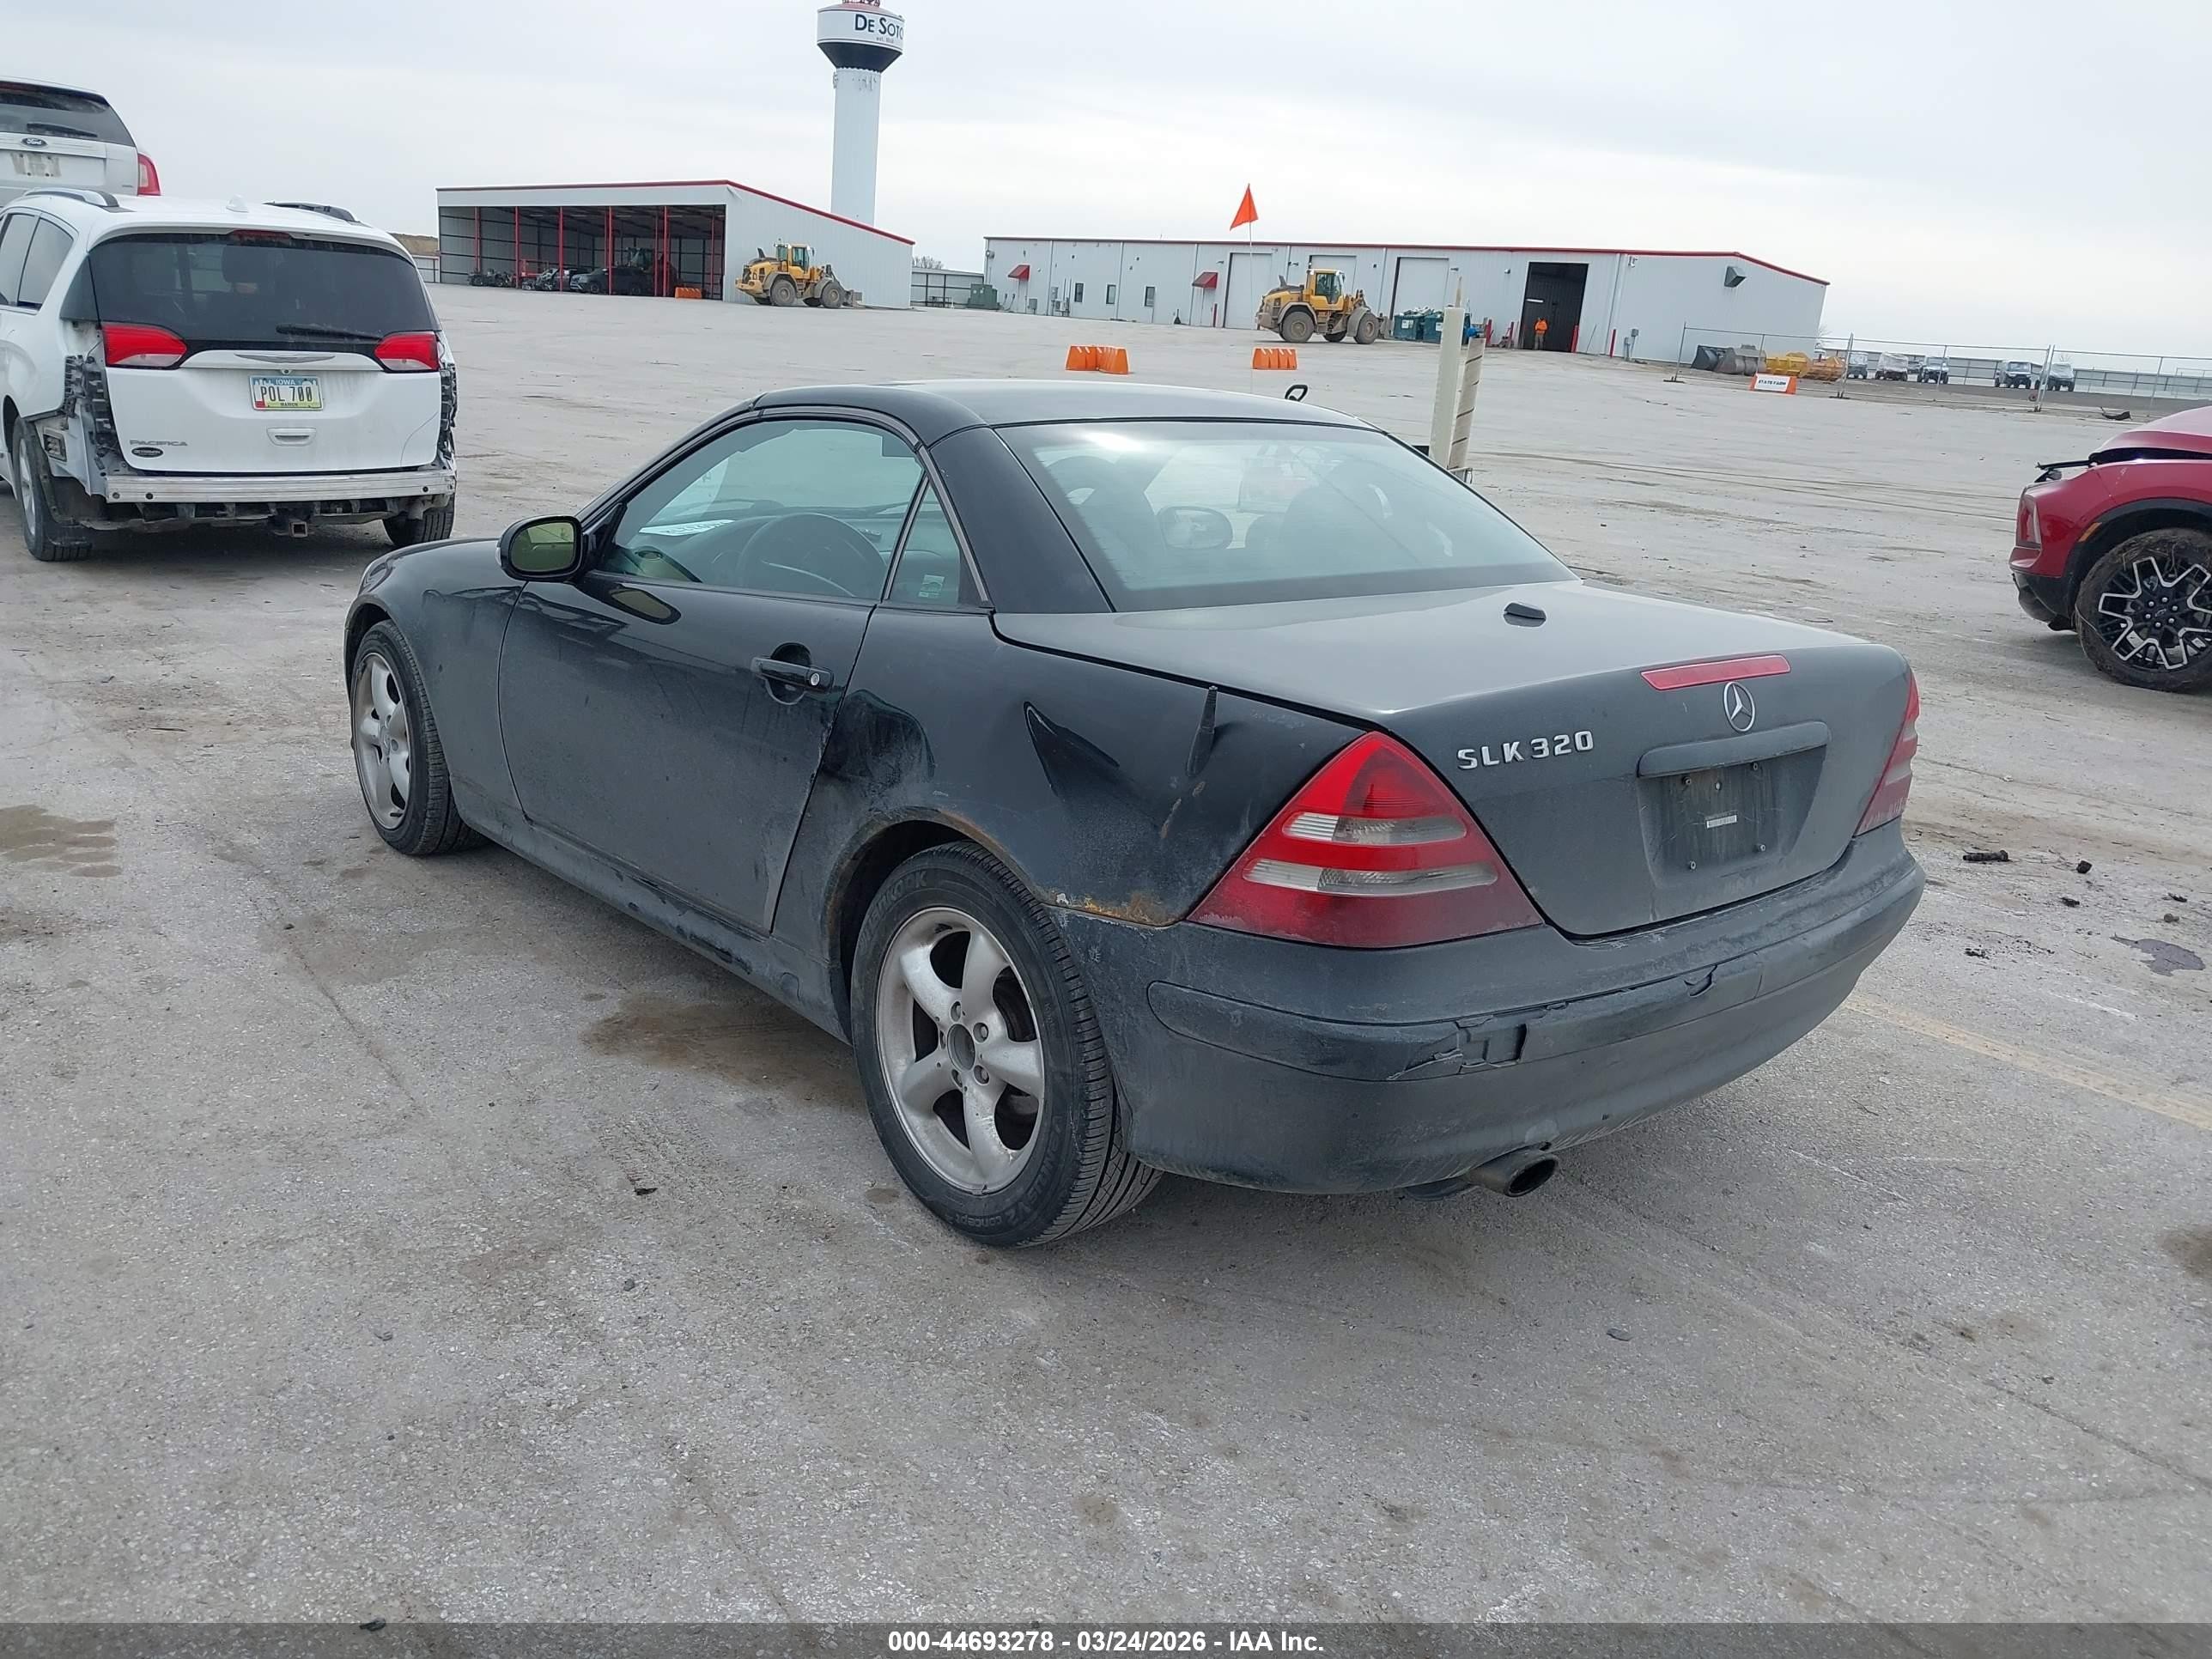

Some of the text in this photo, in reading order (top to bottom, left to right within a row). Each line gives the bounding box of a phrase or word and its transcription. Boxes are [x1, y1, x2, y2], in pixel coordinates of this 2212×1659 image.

[260, 386, 313, 402] POL 700
[1457, 731, 1595, 769] SLK 320
